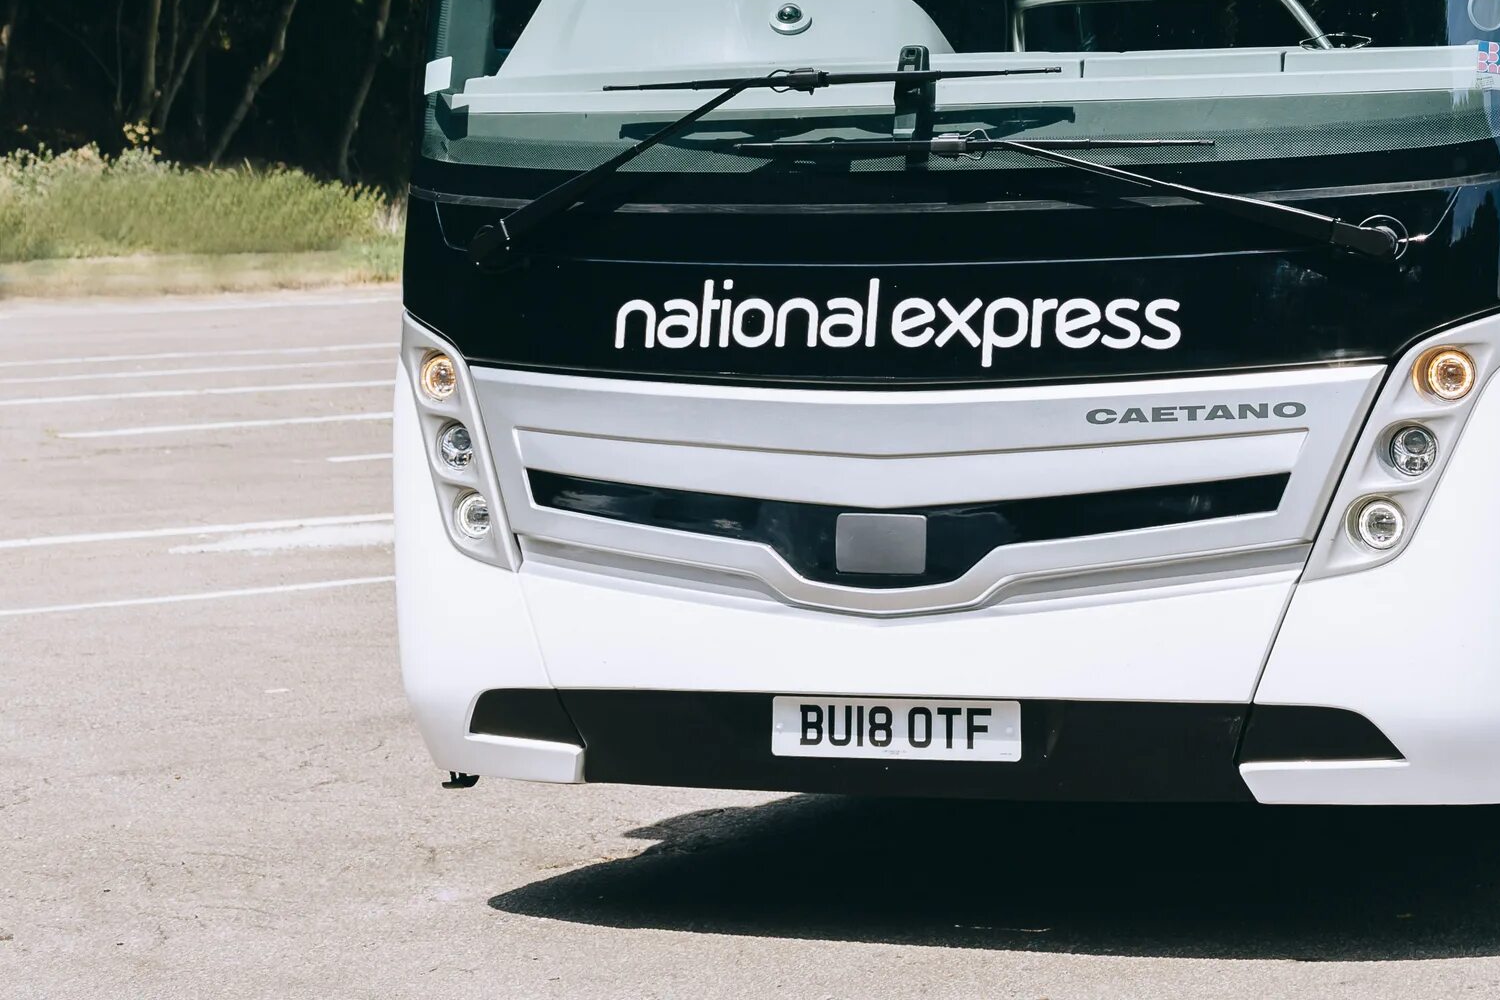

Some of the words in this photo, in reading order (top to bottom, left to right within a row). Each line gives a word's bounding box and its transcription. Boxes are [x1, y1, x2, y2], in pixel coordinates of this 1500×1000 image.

[614, 277, 881, 349] national
[890, 296, 1182, 368] express
[1085, 401, 1307, 425] CAETANO
[799, 704, 893, 747] BU18
[907, 706, 992, 750] OTF
